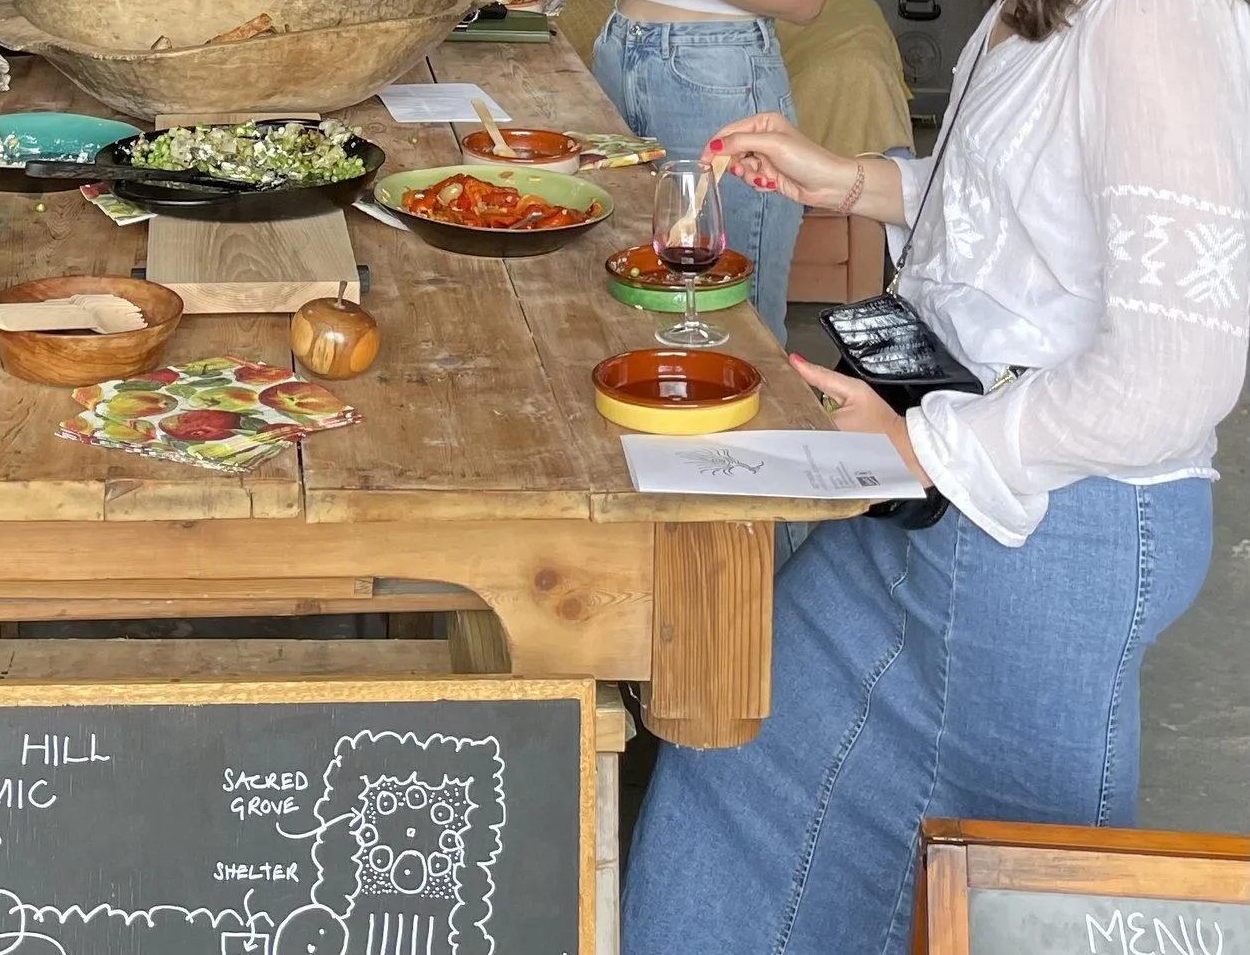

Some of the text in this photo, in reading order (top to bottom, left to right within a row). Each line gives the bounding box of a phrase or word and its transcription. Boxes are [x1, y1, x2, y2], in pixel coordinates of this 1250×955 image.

[21, 733, 111, 767] HILL
[222, 768, 309, 792] SACRED
[230, 796, 300, 820] GROVE
[213, 861, 300, 883] SHELTER
[1085, 909, 1224, 955] MENU
